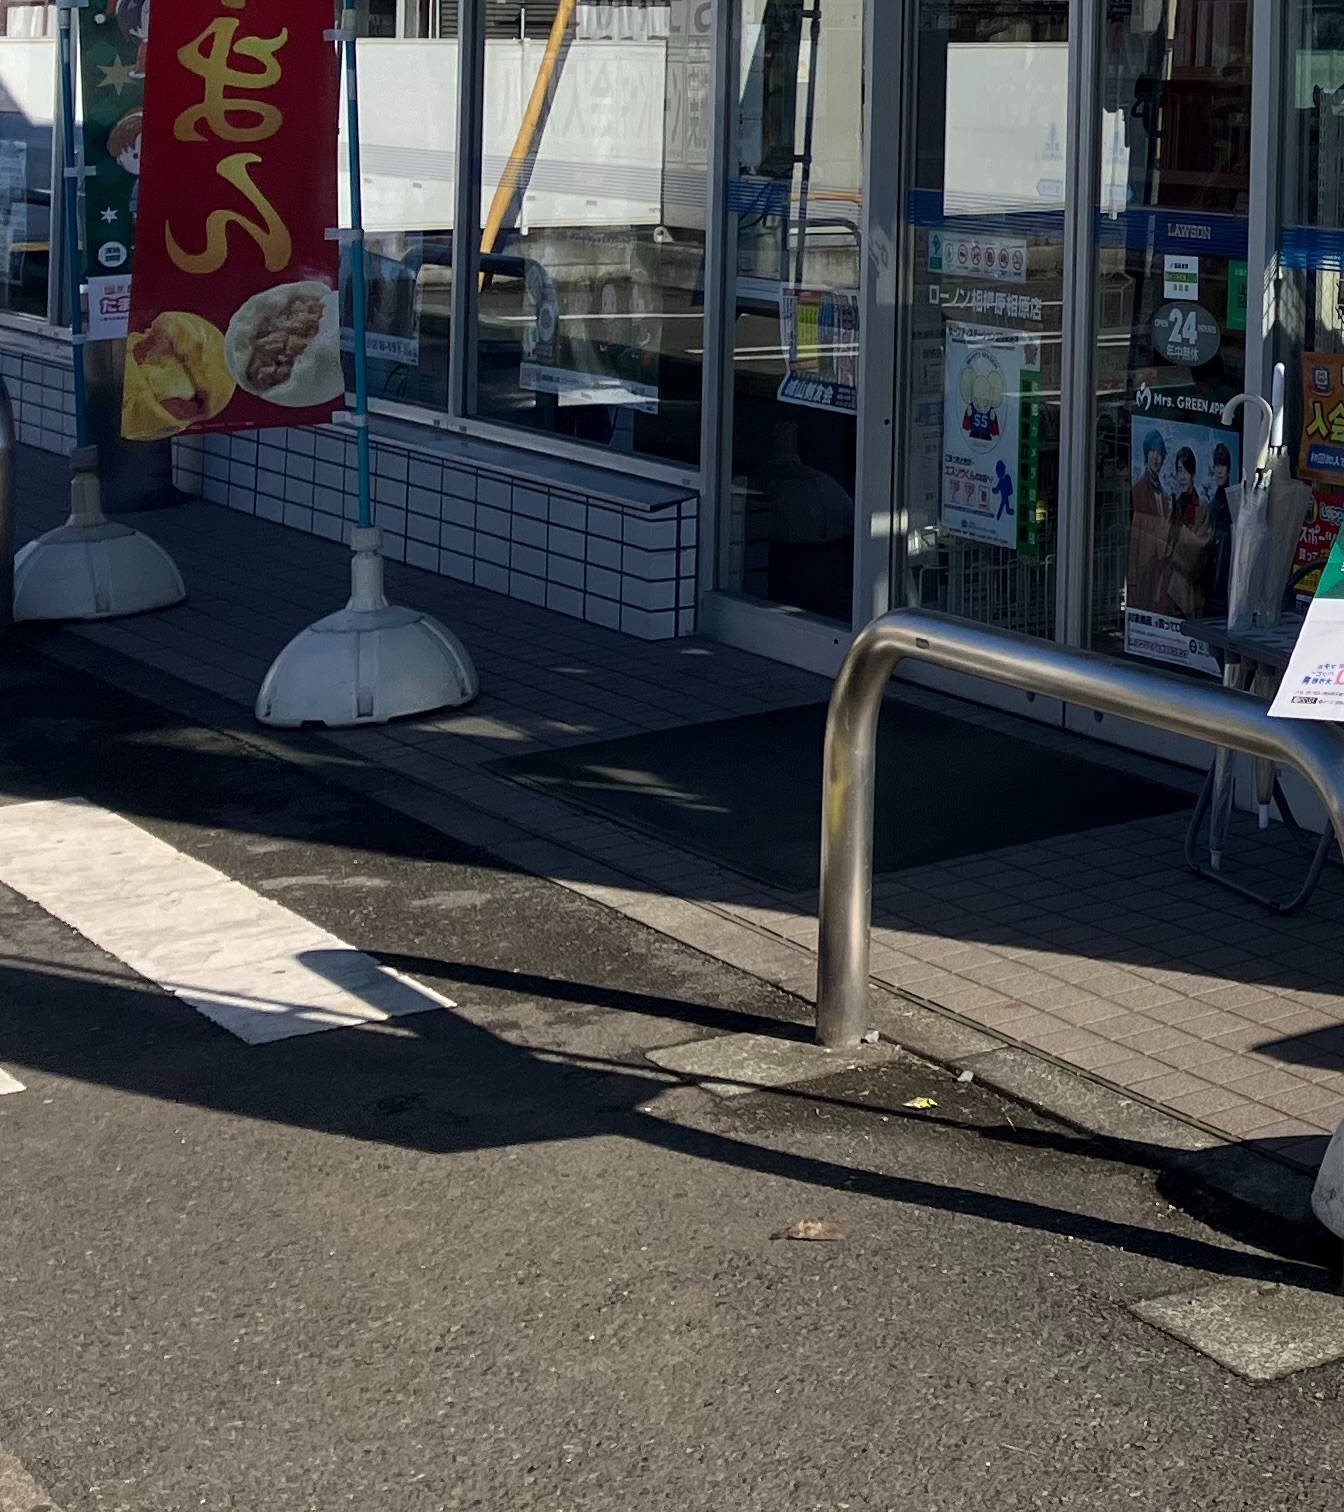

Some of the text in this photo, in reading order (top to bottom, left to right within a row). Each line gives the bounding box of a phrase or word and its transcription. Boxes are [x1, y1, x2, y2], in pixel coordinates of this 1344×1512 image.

[1168, 223, 1211, 239] LAWSON
[1168, 307, 1198, 345] 24
[1167, 344, 1199, 361] 年中無休
[1153, 393, 1174, 408] Mrs.
[1177, 395, 1208, 413] GREEN
